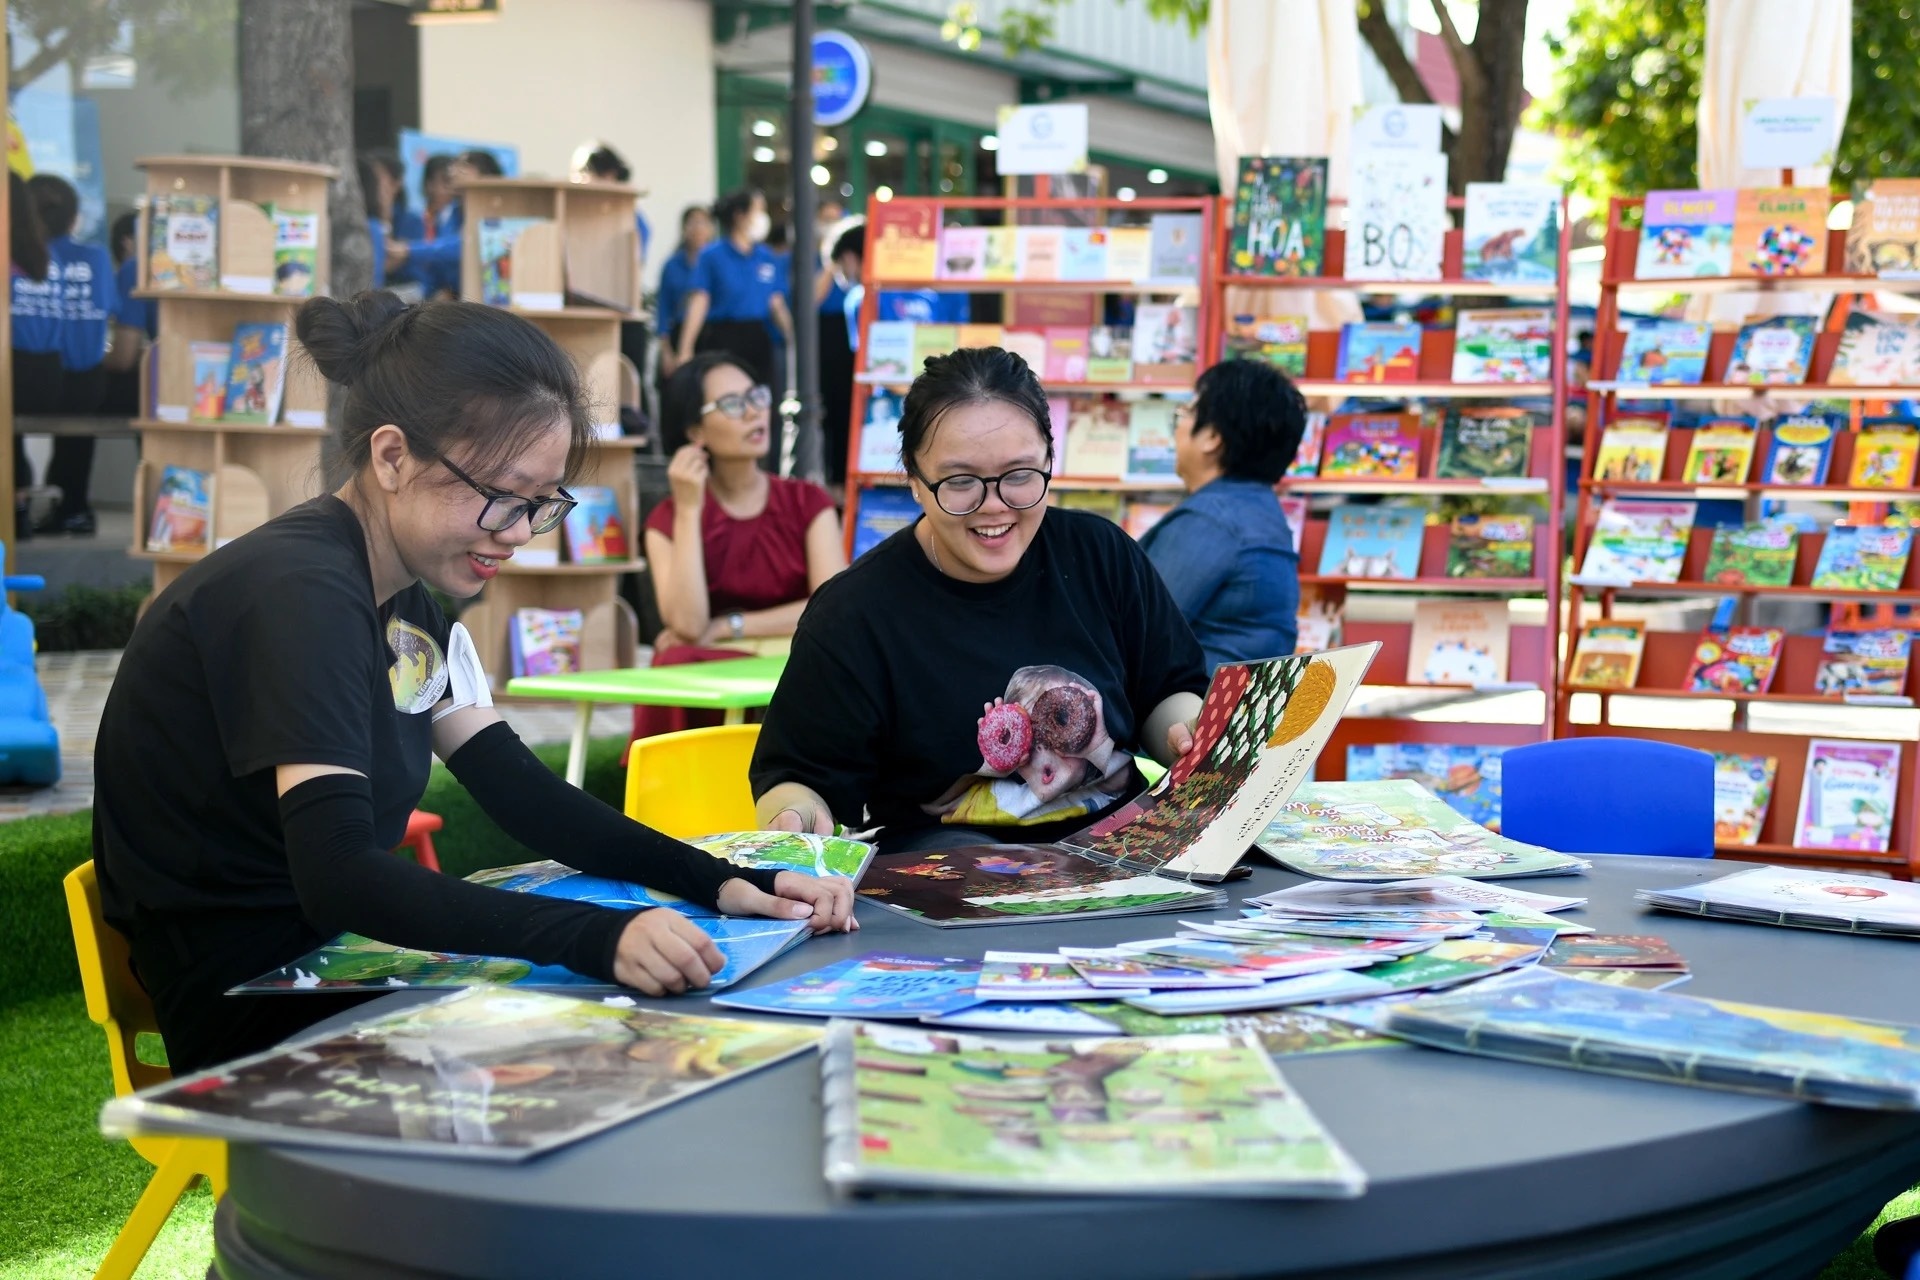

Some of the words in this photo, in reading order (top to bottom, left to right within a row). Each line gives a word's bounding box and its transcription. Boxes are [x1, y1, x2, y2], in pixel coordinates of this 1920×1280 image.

[1759, 201, 1805, 214] ELMER
[1247, 218, 1305, 260] HOA
[1265, 780, 1288, 808] công
